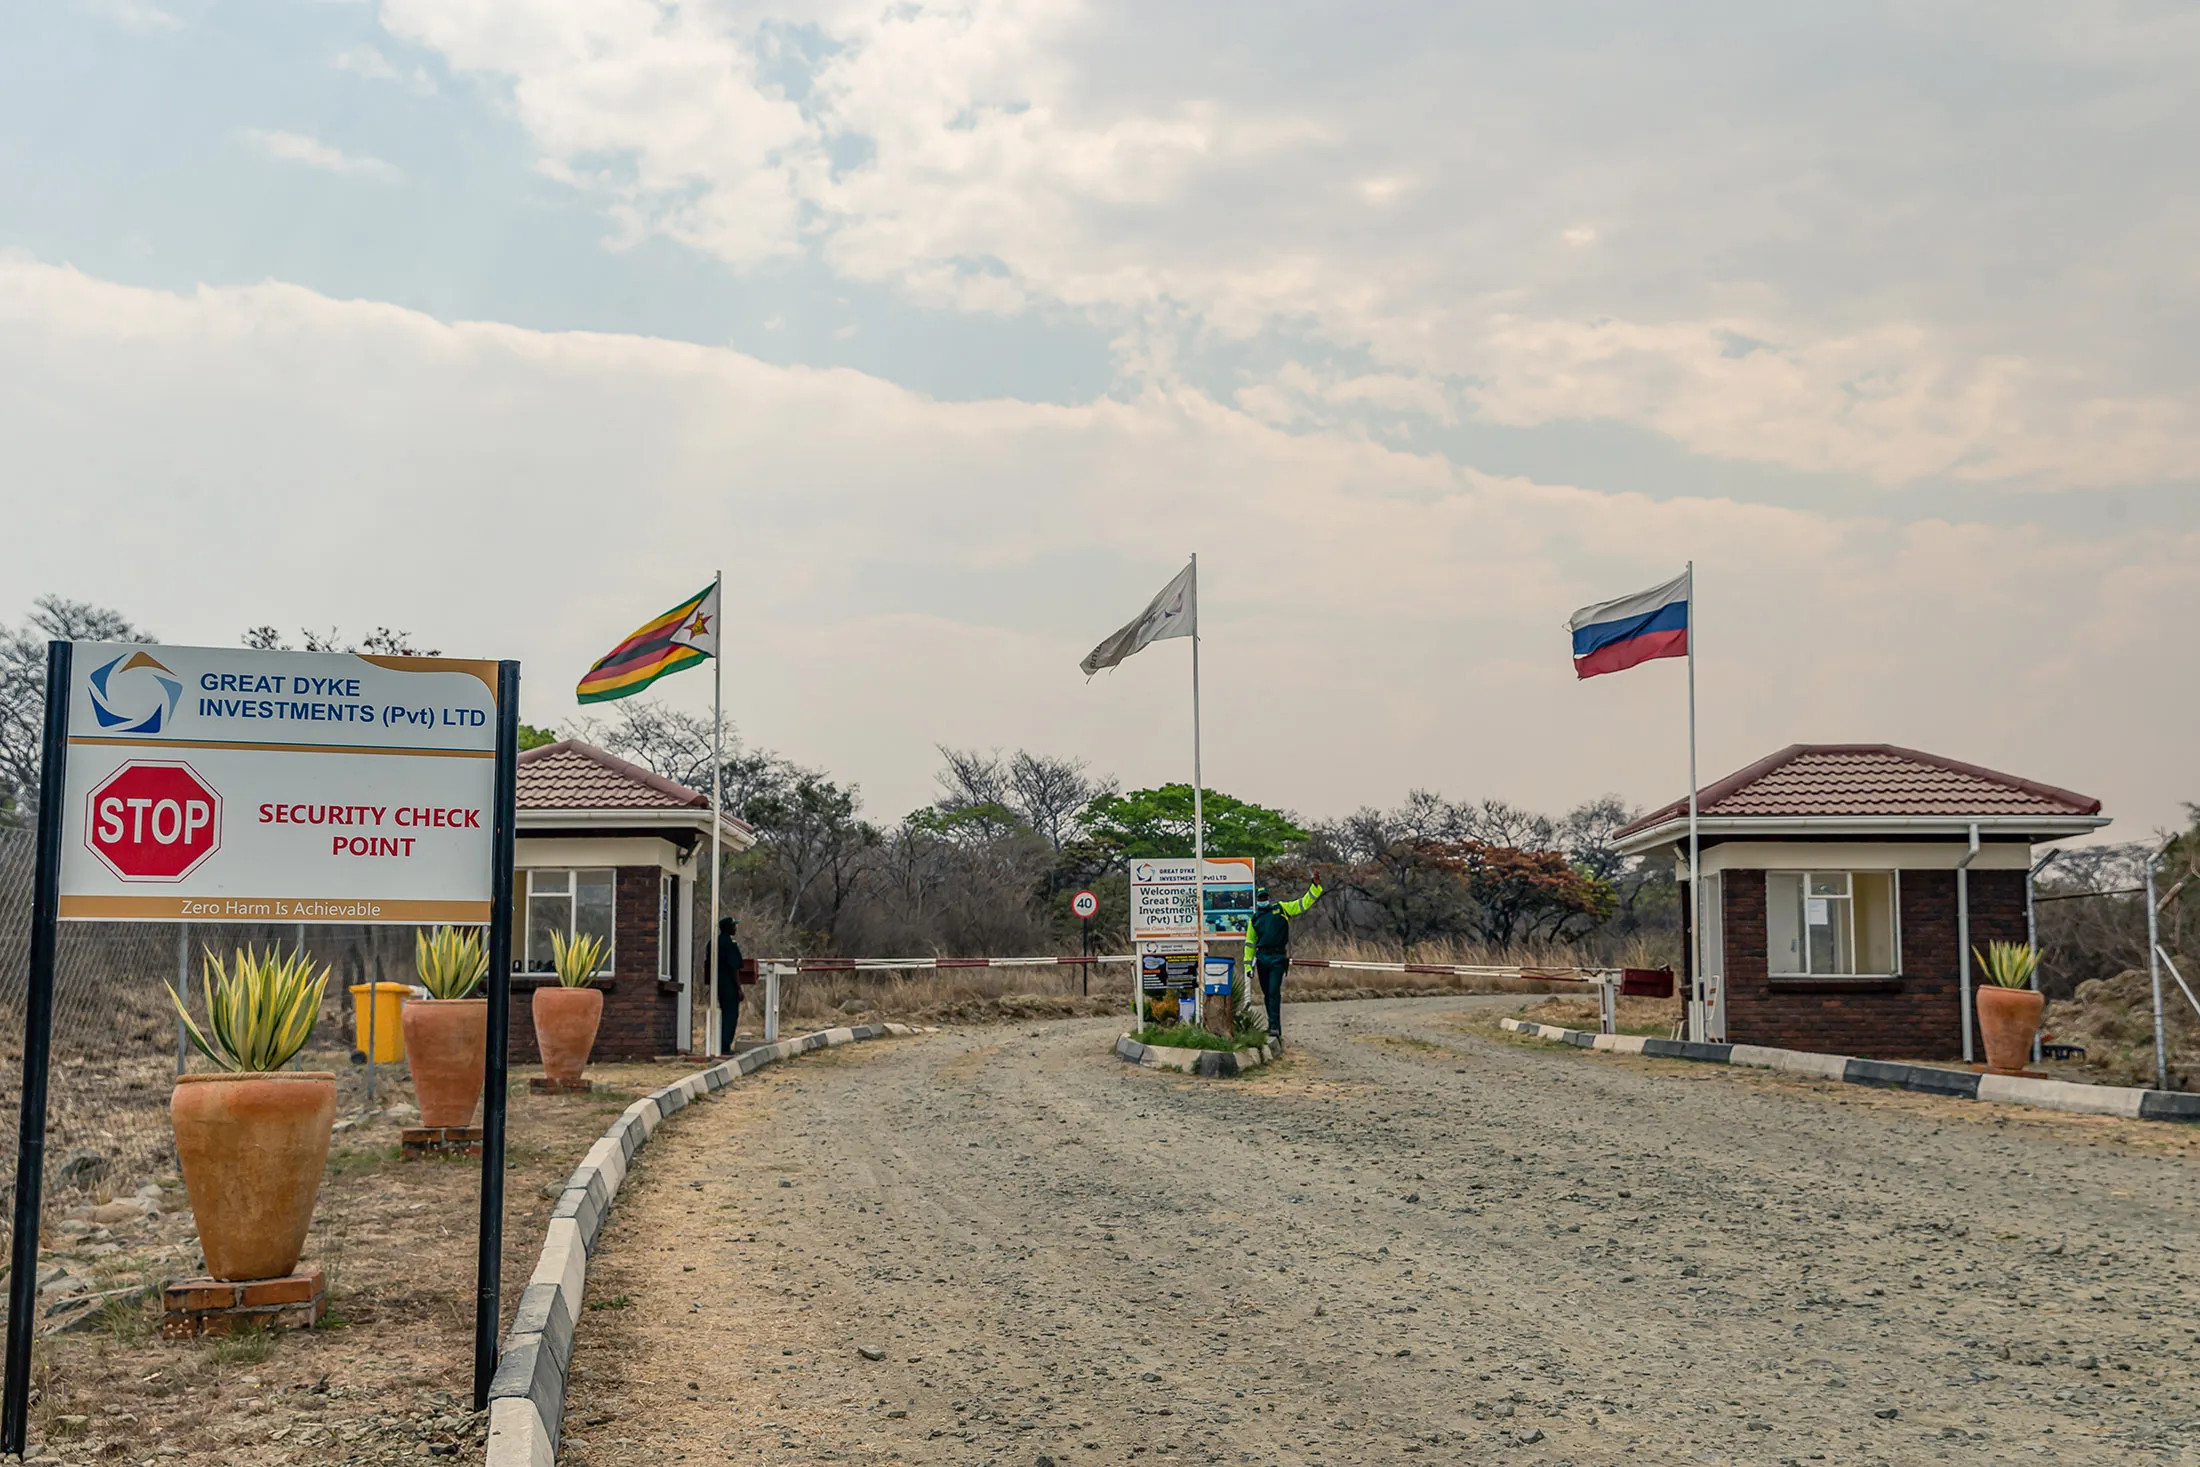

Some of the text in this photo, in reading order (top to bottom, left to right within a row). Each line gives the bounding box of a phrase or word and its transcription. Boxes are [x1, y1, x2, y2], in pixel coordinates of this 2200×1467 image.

[199, 672, 361, 697] GREAT DYKE
[199, 698, 487, 730] INVESTMENTS (Pvt) LTD
[97, 796, 210, 846] STOP
[258, 803, 481, 829] SECURITY CHECK
[332, 836, 416, 858] POINT
[1140, 887, 1186, 896] Welcome
[1141, 896, 1197, 907] Great Dyke
[181, 899, 382, 917] Zero Harm Is Achievable
[1076, 897, 1093, 909] 40
[1146, 914, 1193, 925] (Pvt) LTD
